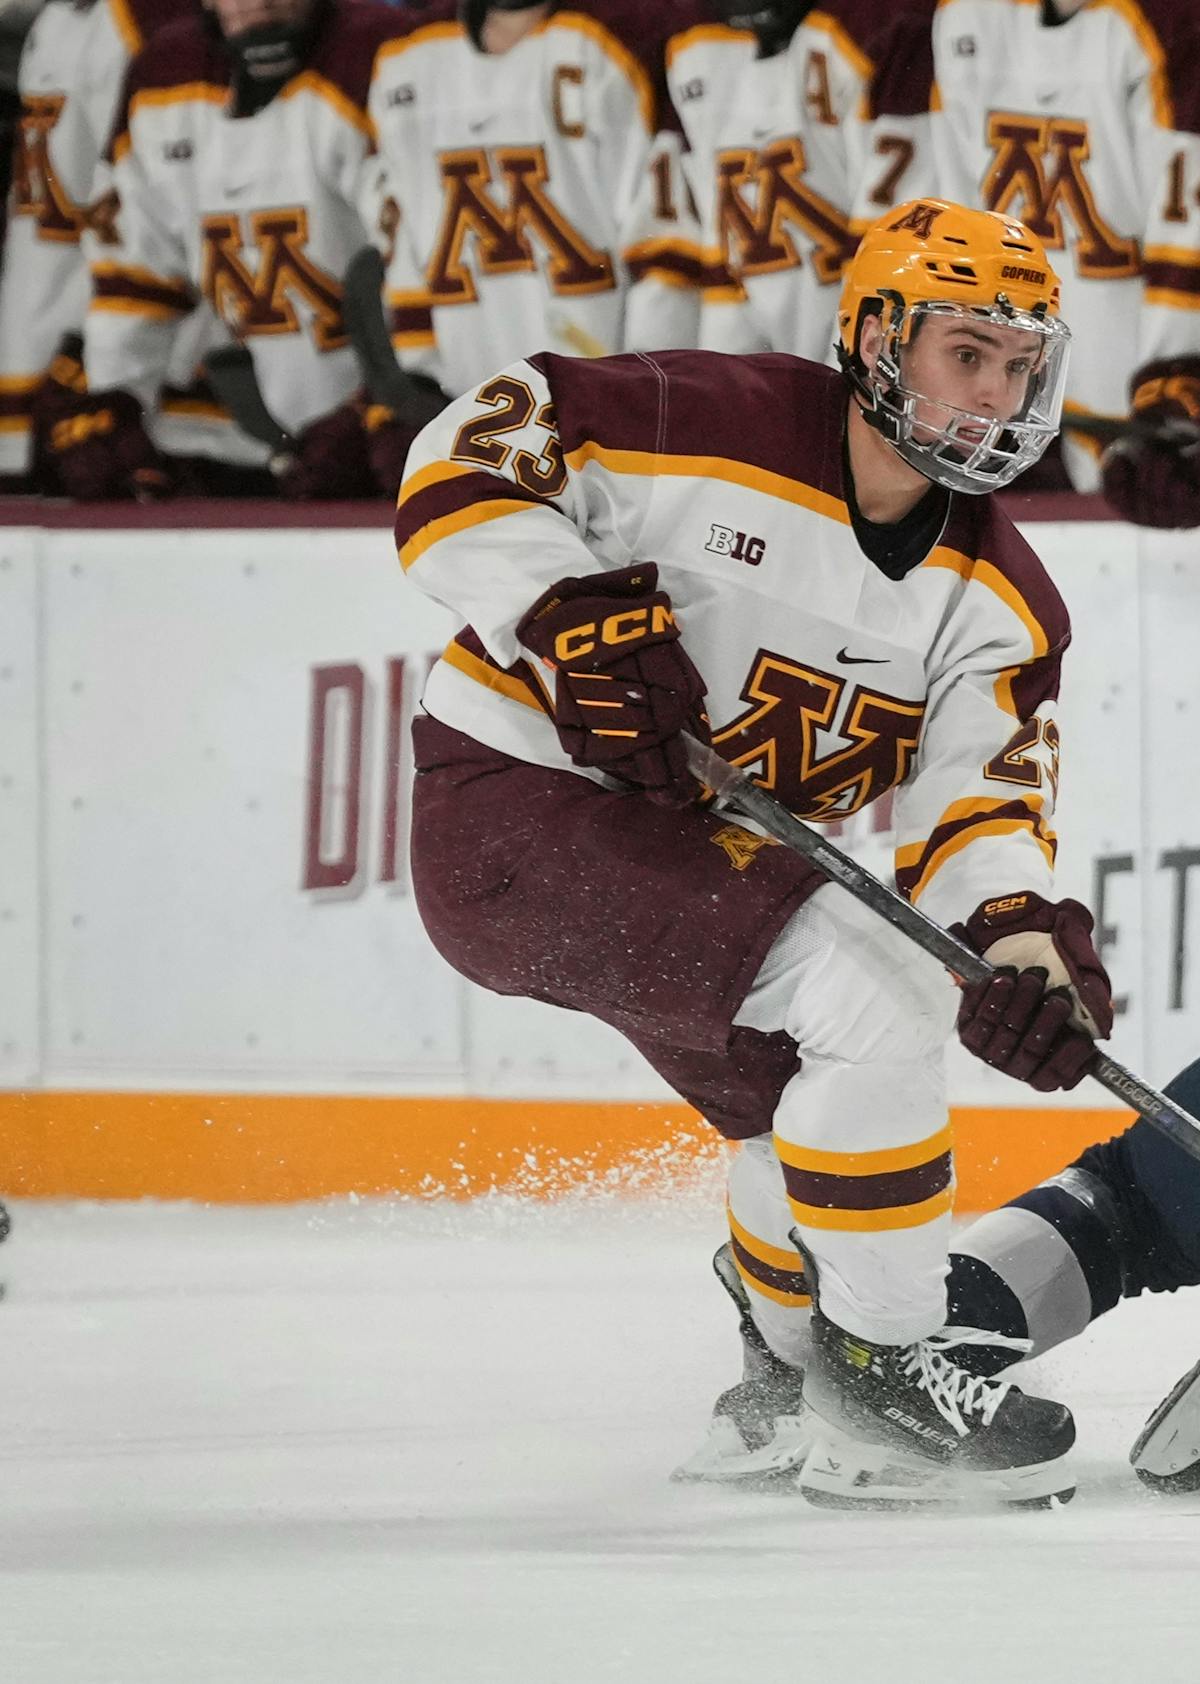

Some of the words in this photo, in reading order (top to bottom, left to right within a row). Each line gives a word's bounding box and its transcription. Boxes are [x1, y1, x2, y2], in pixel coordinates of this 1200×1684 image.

[552, 64, 585, 138] C
[807, 50, 838, 125] A
[427, 144, 617, 302] M
[716, 137, 864, 285] M
[872, 136, 914, 205] 7
[980, 109, 1143, 280] M
[203, 206, 350, 352] M
[1001, 265, 1047, 285] GOPHERS
[450, 374, 570, 498] 23
[700, 647, 928, 823] M
[984, 895, 1028, 913] CCM
